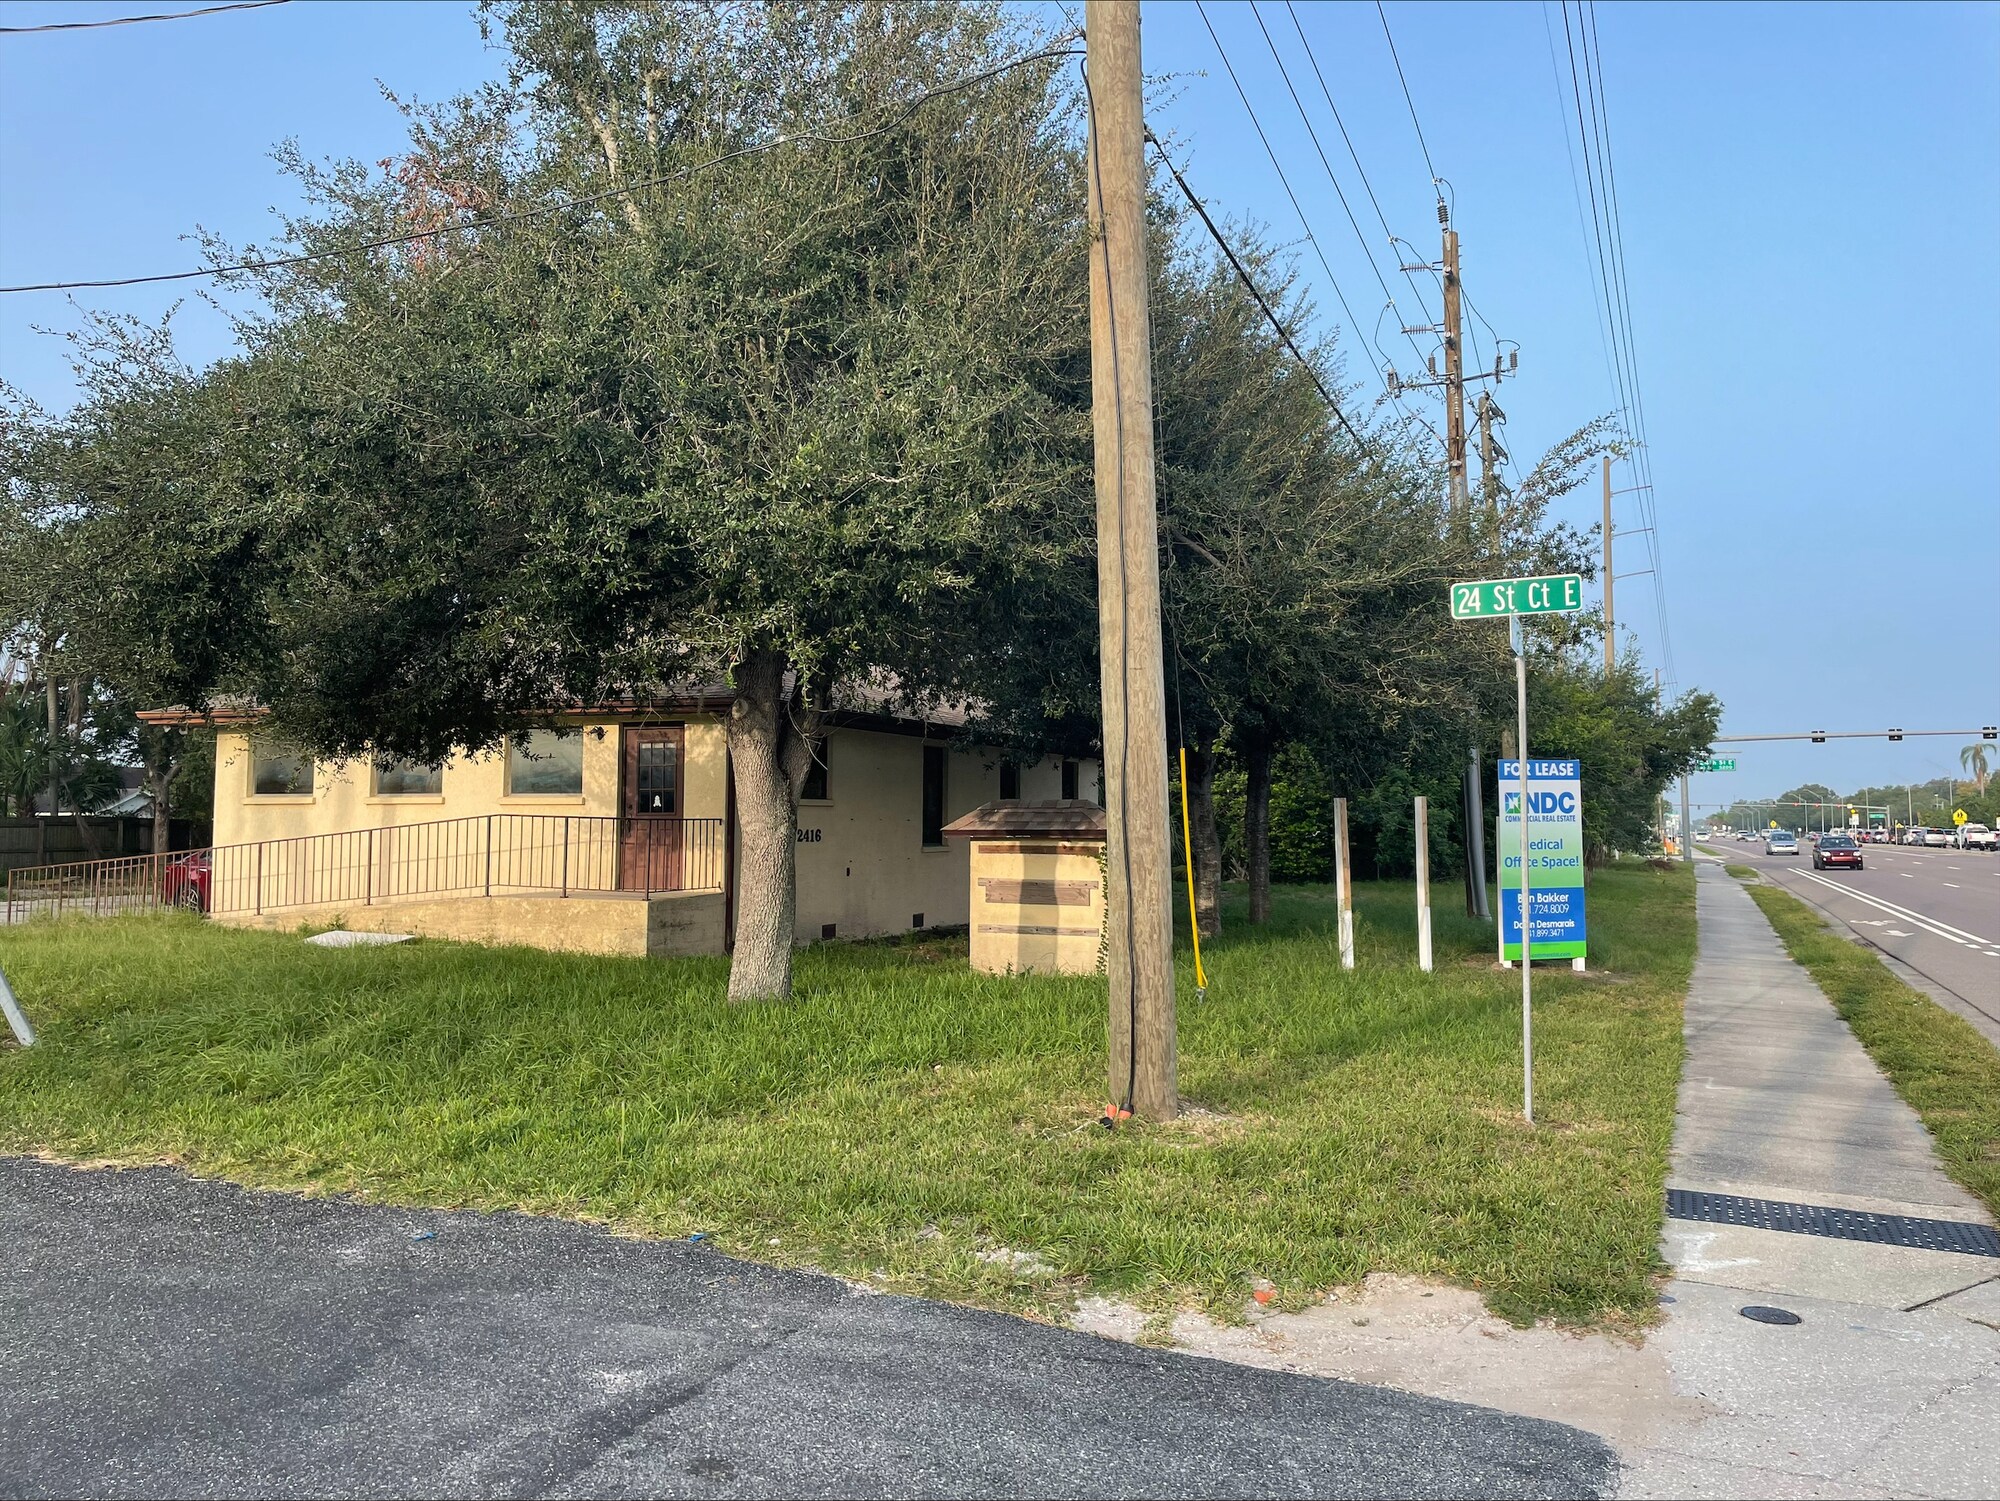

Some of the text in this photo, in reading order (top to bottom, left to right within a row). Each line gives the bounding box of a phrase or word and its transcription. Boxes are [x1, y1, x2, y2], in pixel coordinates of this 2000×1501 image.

[1458, 580, 1577, 614] 24 St Ct E
[1535, 762, 1574, 776] LEASE
[1527, 791, 1575, 814] NDC
[1542, 815, 1556, 823] REAL
[797, 829, 821, 842] 2416
[1520, 838, 1563, 850] edical
[1541, 856, 1579, 869] Space!
[1517, 892, 1569, 904] Bn Bakker
[1517, 903, 1570, 915] 91.724.8009
[1536, 919, 1575, 929] Desmarais
